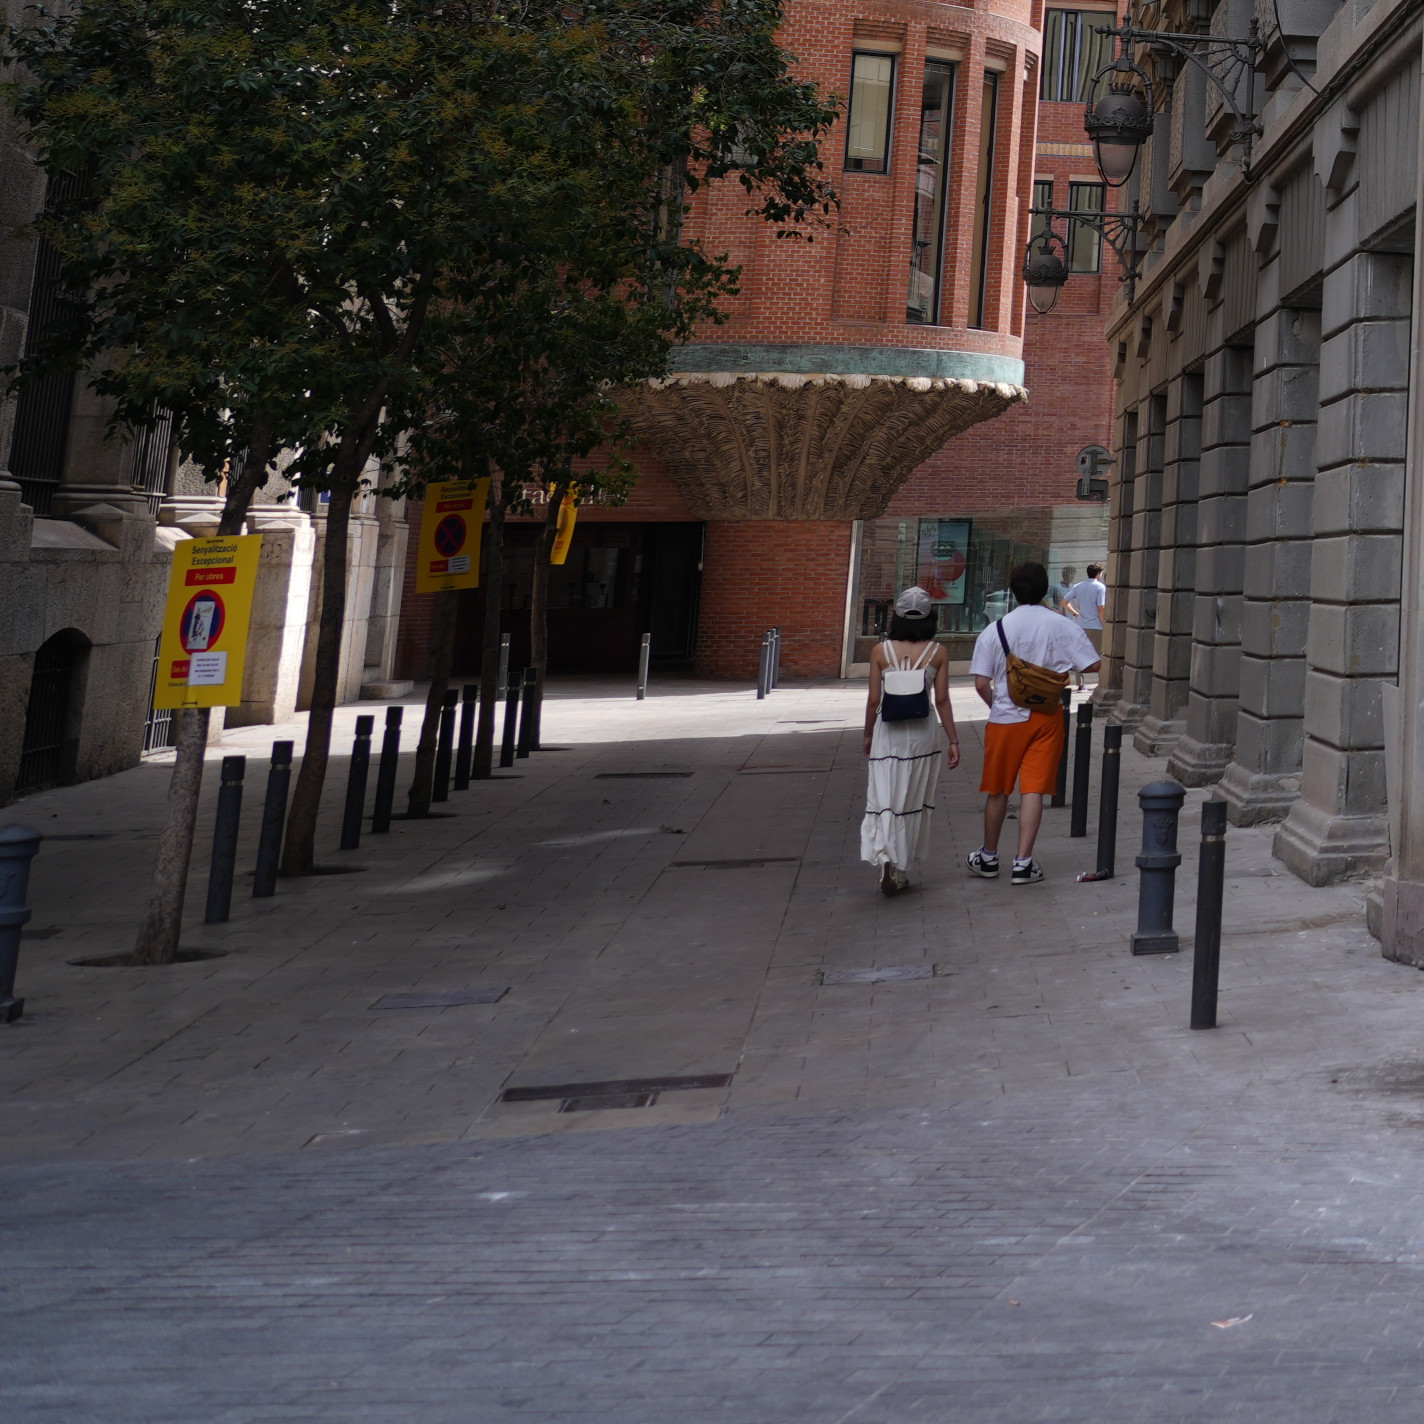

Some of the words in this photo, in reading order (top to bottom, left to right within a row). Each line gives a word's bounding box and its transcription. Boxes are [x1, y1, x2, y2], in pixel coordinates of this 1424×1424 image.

[192, 544, 238, 556] Senyalització
[192, 555, 234, 566] Excepcional
[194, 573, 205, 581] Per
[206, 572, 224, 580] obres
